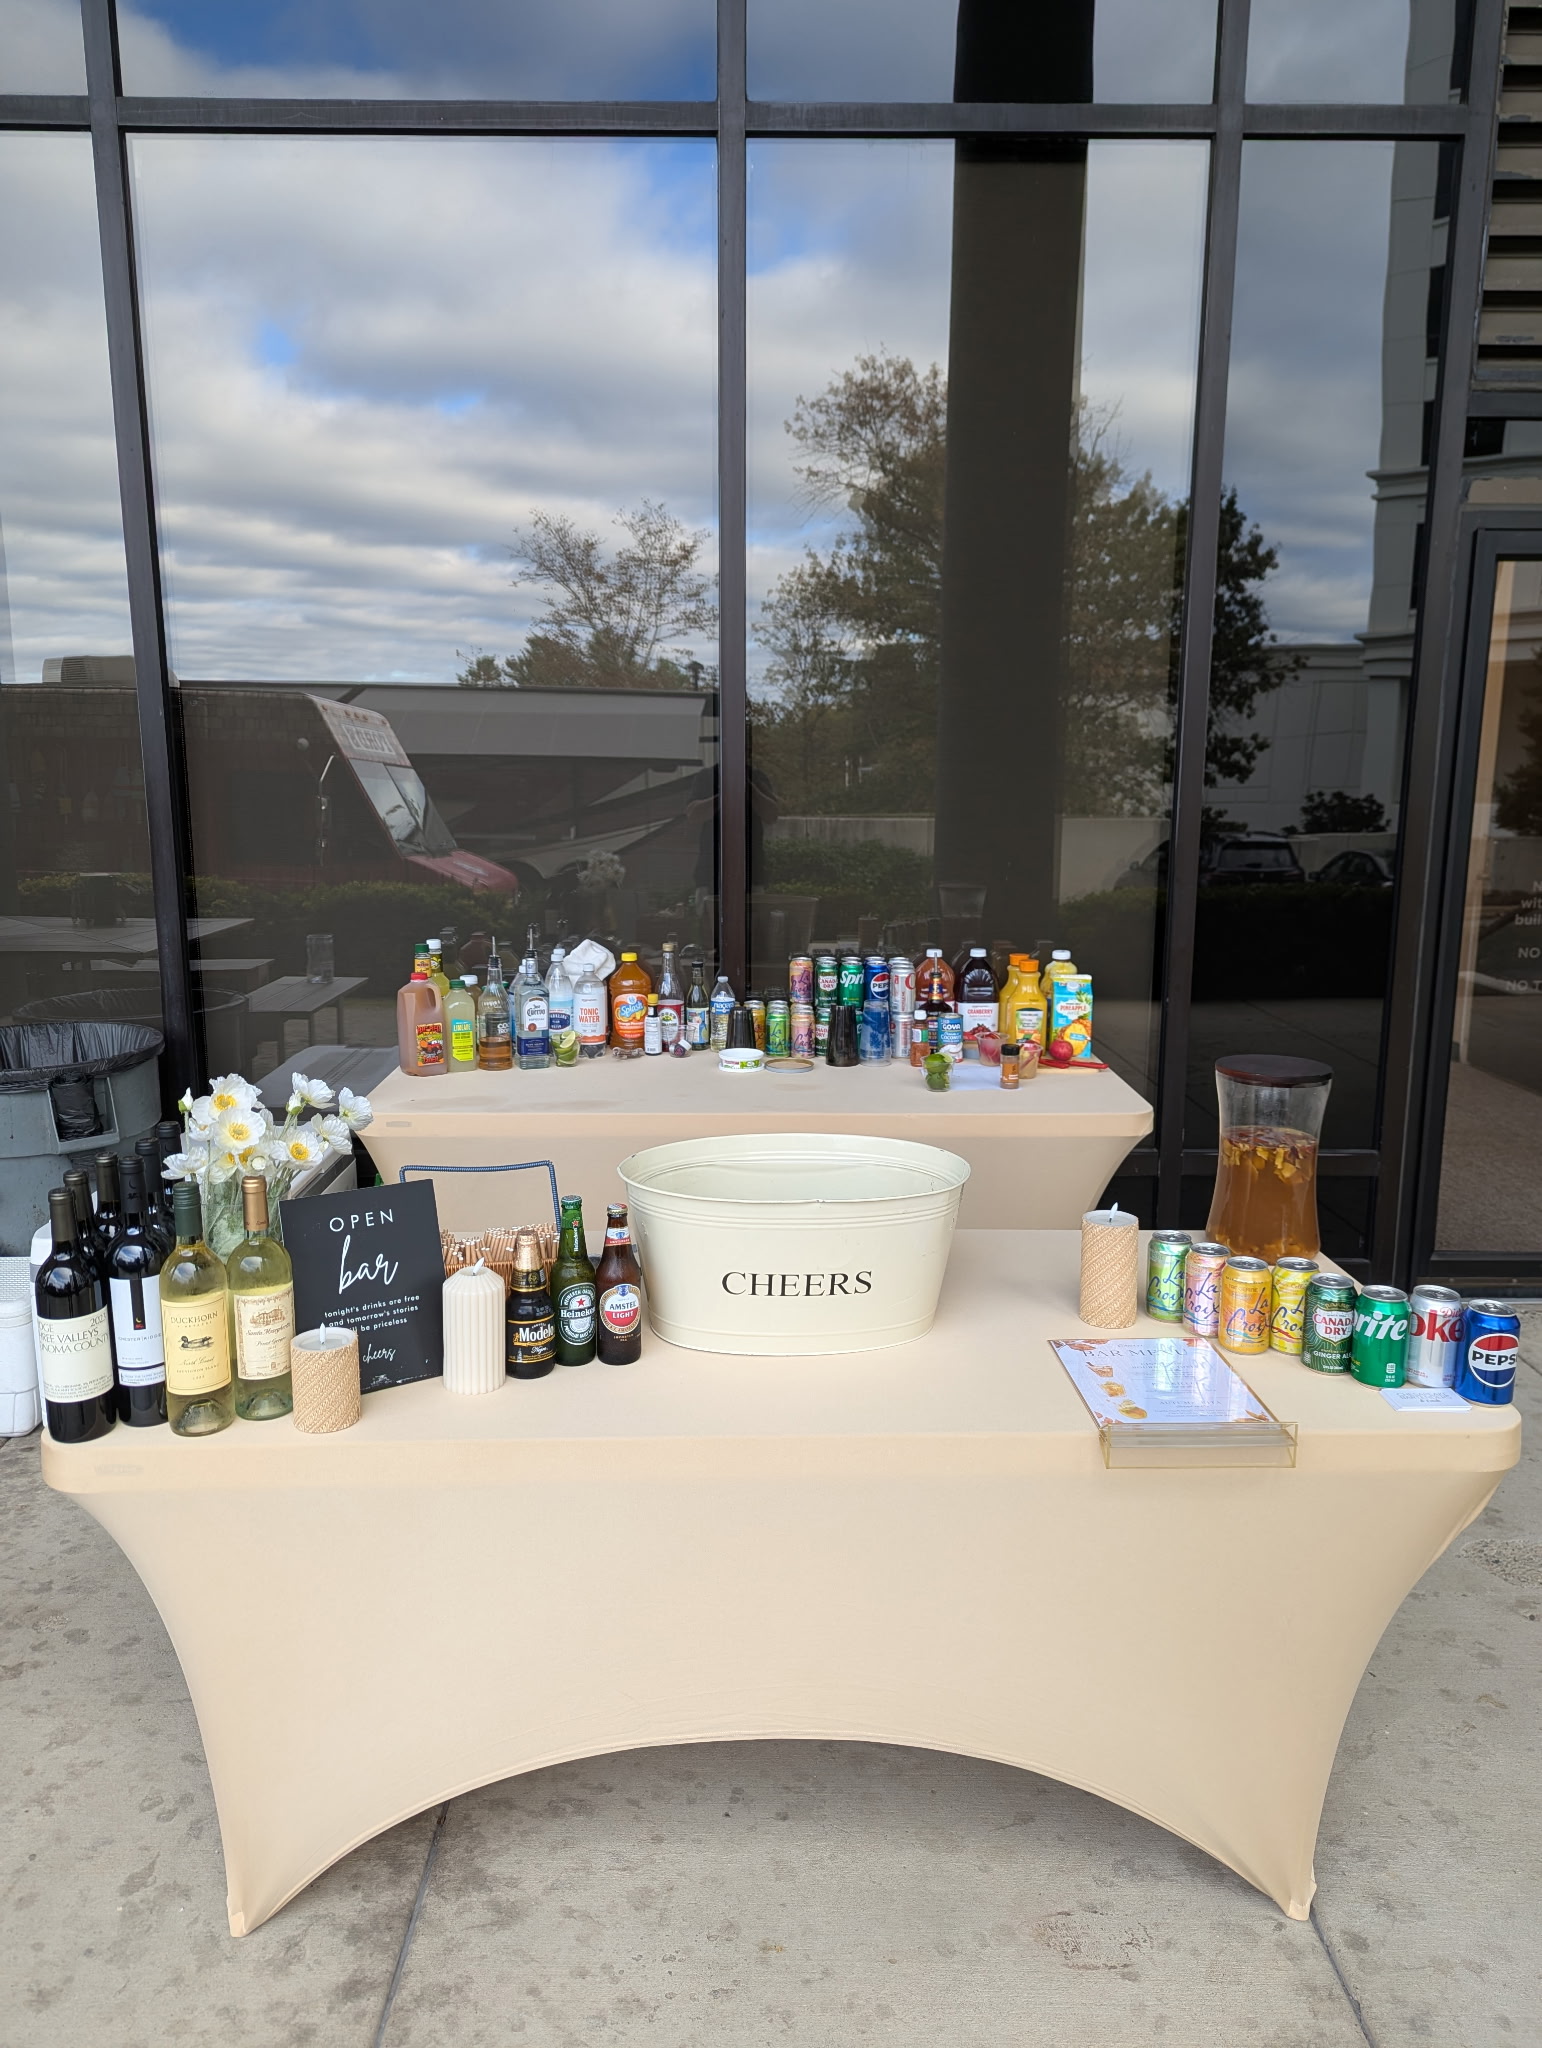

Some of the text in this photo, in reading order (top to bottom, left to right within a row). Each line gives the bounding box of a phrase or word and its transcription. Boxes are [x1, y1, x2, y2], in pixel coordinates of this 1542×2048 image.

[1518, 947, 1540, 958] NO
[1506, 980, 1528, 991] NO
[578, 1015, 600, 1023] WATER
[580, 1008, 598, 1016] TONIC
[329, 1208, 394, 1232] OPEN
[338, 1234, 399, 1295] bar
[721, 1270, 873, 1297] CHEERS
[1195, 1272, 1219, 1300] La
[325, 1294, 420, 1318] tonight's drinks are free
[609, 1300, 637, 1311] AMSTEL
[1248, 1287, 1269, 1315] La
[170, 1310, 218, 1324] DUCKHORN
[328, 1304, 419, 1328] and tomorrow's stories
[612, 1310, 634, 1319] LIGHT
[360, 1323, 370, 1332] be
[373, 1317, 408, 1331] priceless
[1324, 1326, 1348, 1336] DRY
[1353, 1311, 1405, 1341] rite
[56, 1327, 99, 1344] VALLEYS
[362, 1343, 396, 1364] cheers
[1313, 1350, 1341, 1359] GINGER
[1472, 1349, 1517, 1366] PEPS
